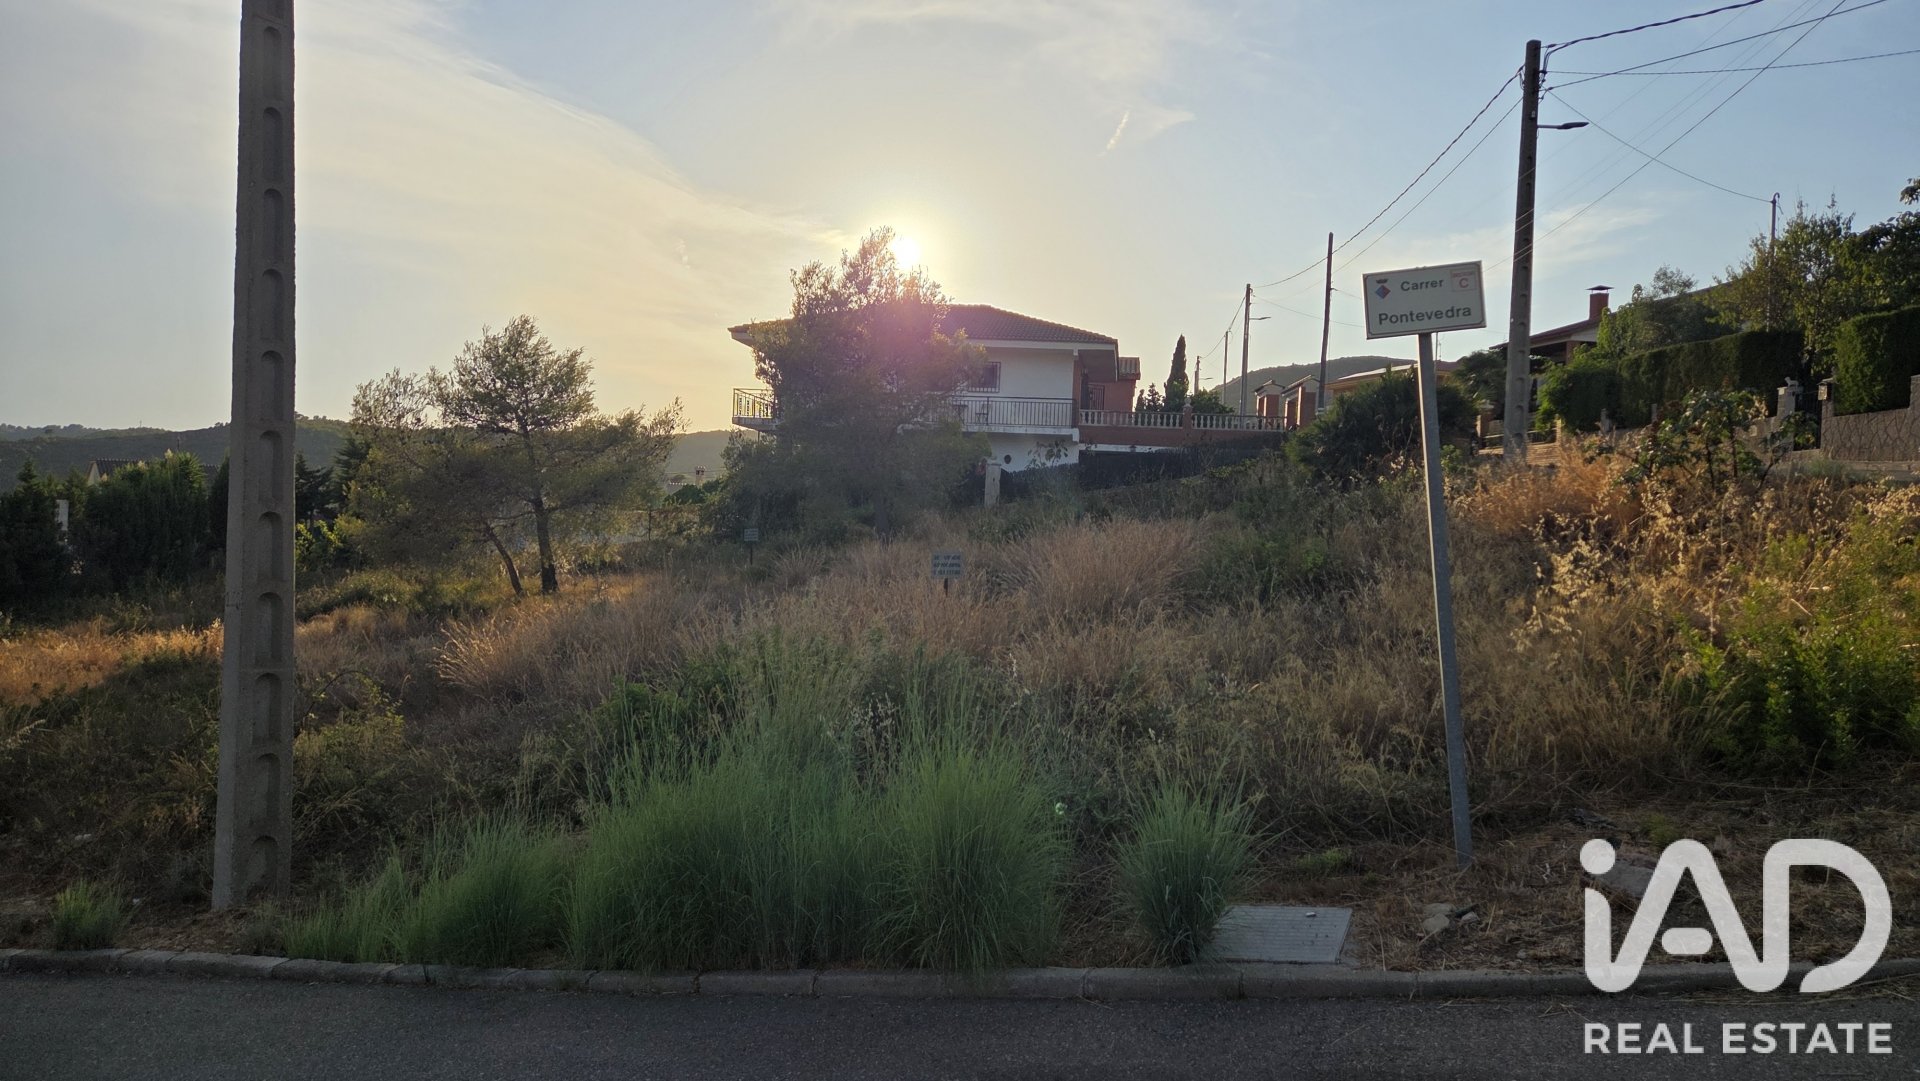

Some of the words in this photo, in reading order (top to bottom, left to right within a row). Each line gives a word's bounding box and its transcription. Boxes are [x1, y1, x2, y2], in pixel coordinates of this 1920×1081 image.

[1400, 279, 1444, 292] Carrer
[1459, 277, 1469, 288] C
[1378, 305, 1472, 325] Pontevedra
